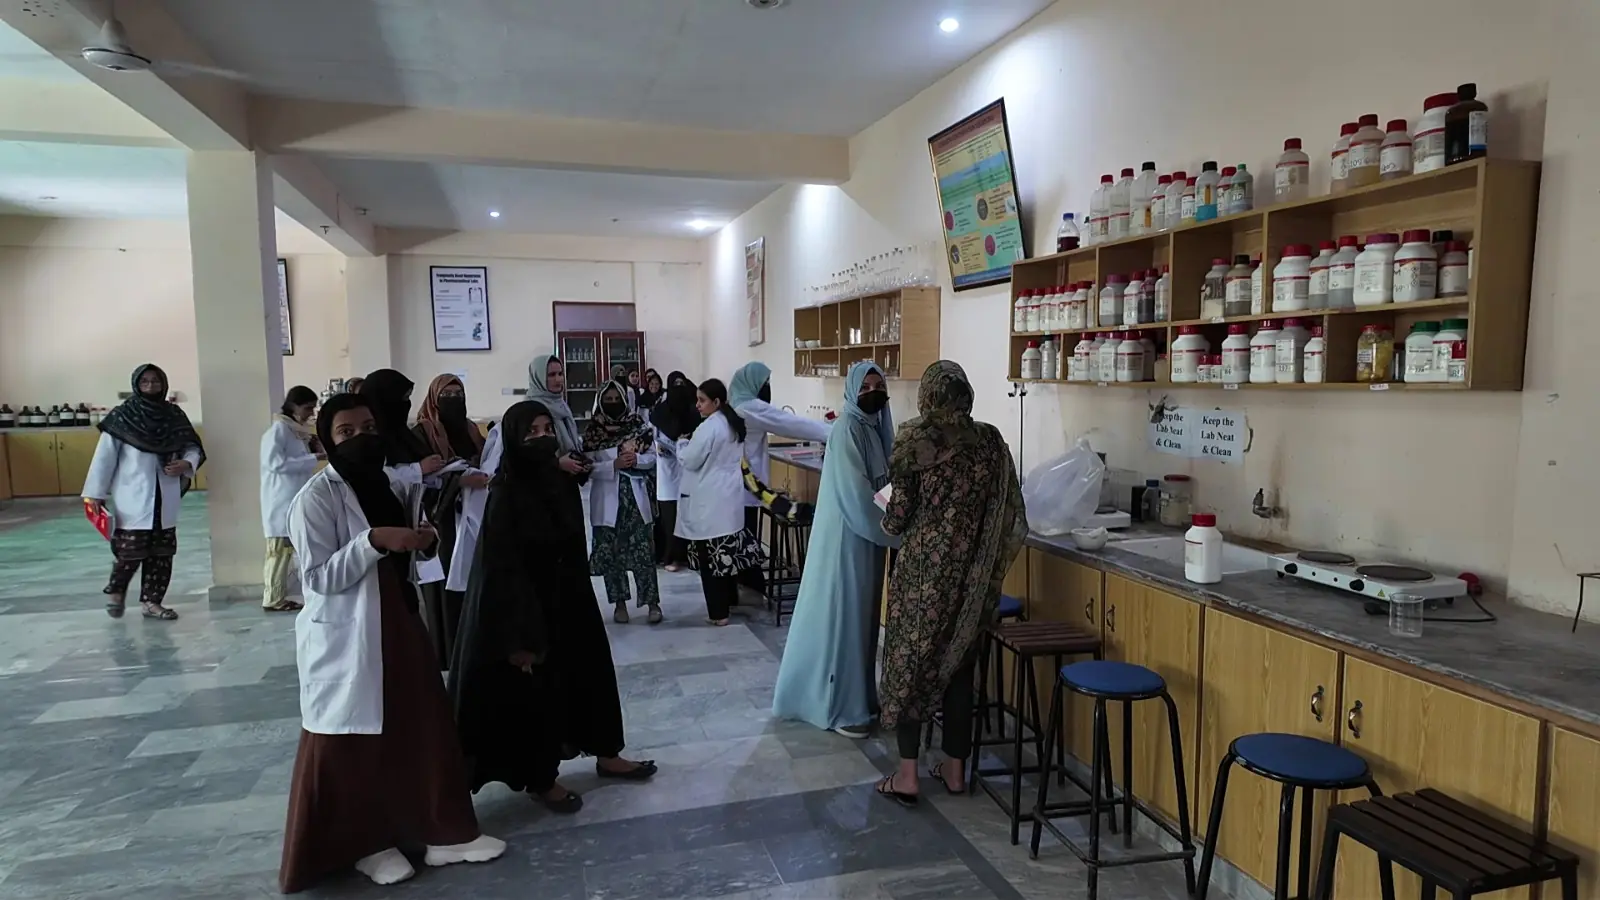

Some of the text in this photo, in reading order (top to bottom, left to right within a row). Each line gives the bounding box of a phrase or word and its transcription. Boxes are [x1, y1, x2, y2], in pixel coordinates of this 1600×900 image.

[1173, 412, 1184, 422] the
[1202, 416, 1234, 428] Keep the
[1156, 424, 1168, 432] Lab
[1201, 430, 1234, 442] Lab Neat
[1156, 438, 1182, 450] & Clean
[1202, 445, 1232, 456] & Clean
